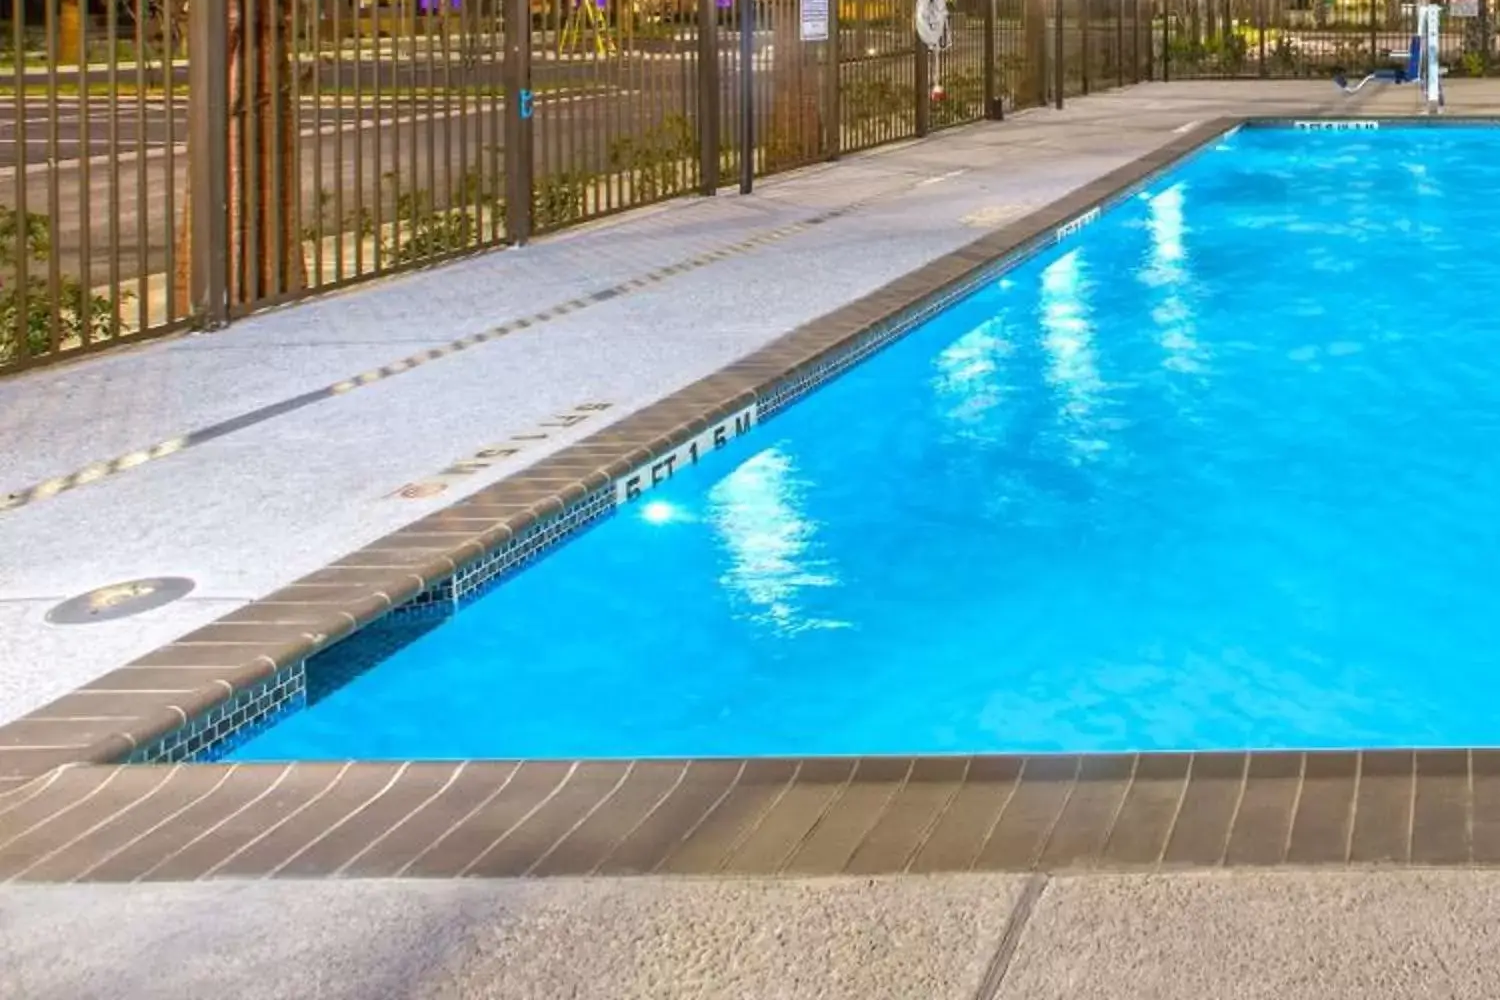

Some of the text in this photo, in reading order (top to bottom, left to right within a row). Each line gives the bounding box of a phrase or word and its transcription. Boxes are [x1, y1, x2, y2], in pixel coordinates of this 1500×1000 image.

[626, 411, 752, 500] 5 FT 1 5 M
